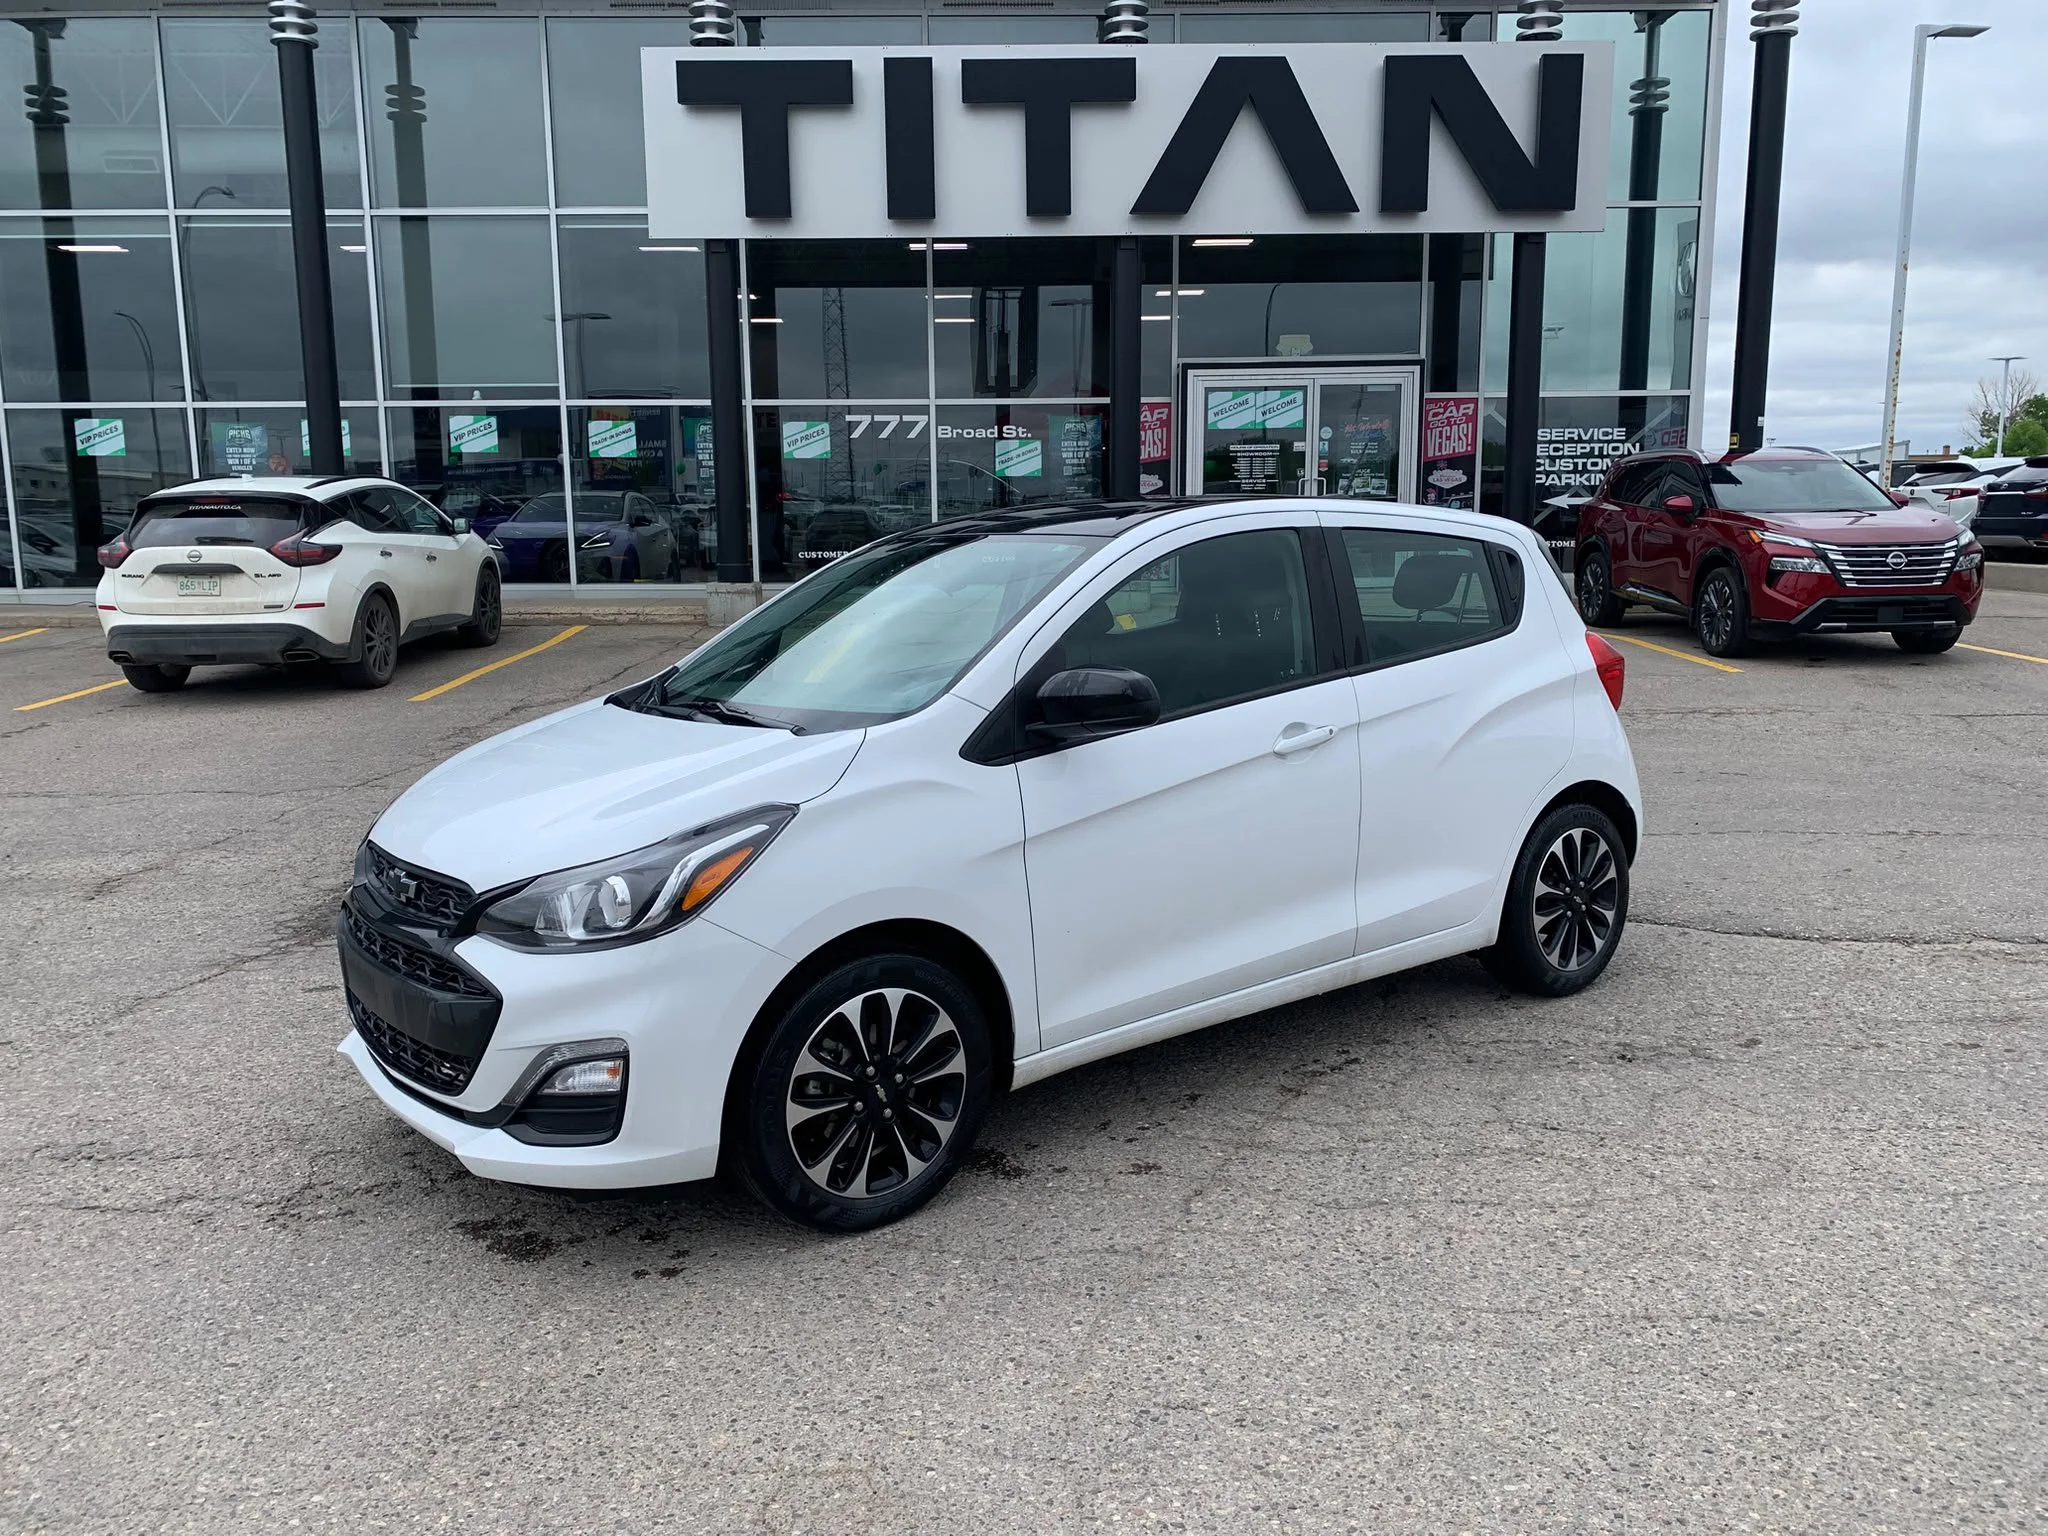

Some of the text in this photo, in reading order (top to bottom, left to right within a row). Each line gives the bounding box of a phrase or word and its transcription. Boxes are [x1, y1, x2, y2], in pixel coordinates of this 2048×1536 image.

[676, 53, 1585, 221] TITAN
[1140, 408, 1168, 421] AR
[1212, 398, 1250, 418] WELCOME
[1261, 397, 1298, 417] WELCOME
[1426, 402, 1447, 410] BUY
[1427, 403, 1475, 421] CAR
[453, 422, 493, 442] VIP PRICES
[845, 414, 1032, 439] 777 Broad St.
[1429, 416, 1466, 428] GO TO
[80, 425, 119, 445] VIP PRICES
[591, 427, 632, 447] TRADE-IN BONUS
[786, 427, 826, 448] VIP PRICES
[1427, 422, 1473, 458] VEGAS!
[1537, 427, 1626, 441] SERVICE
[998, 446, 1039, 466] TRADE-IN BONUS
[1536, 442, 1640, 456] ECEPTION
[179, 580, 218, 591] 865 LIP
